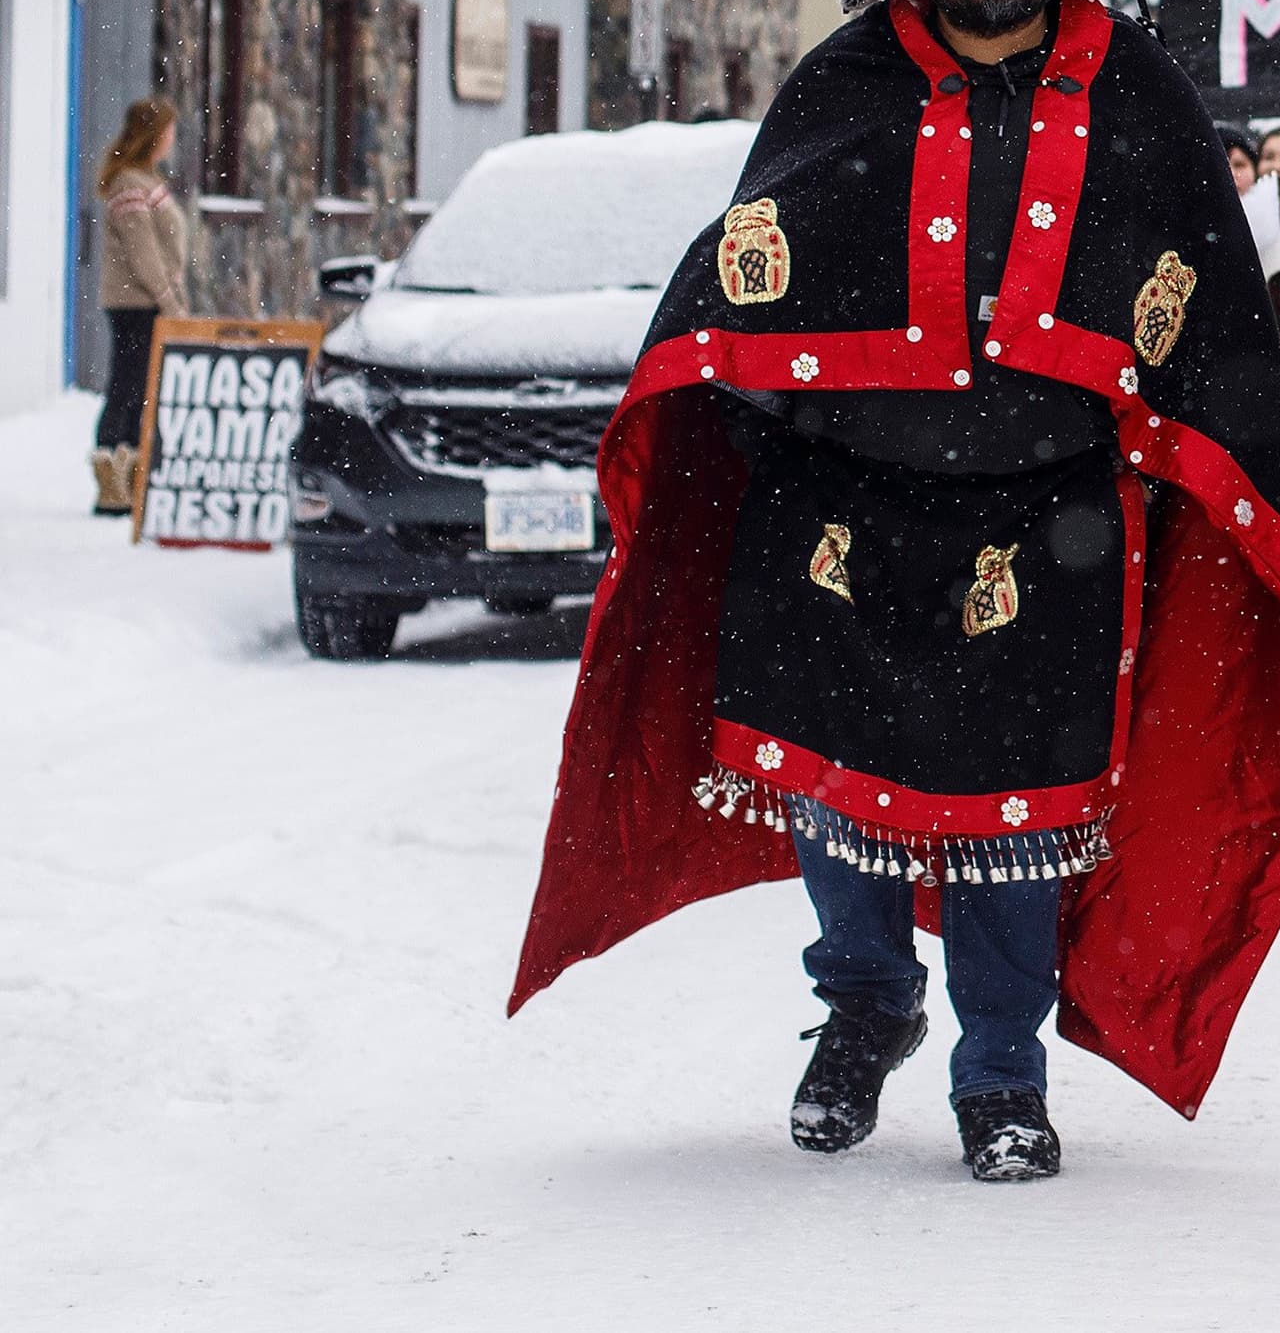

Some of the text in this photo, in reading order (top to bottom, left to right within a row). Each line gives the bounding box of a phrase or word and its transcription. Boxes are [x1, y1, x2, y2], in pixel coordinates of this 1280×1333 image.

[158, 352, 304, 409] MASA
[157, 404, 300, 464] YAMA
[144, 487, 289, 542] RESTO
